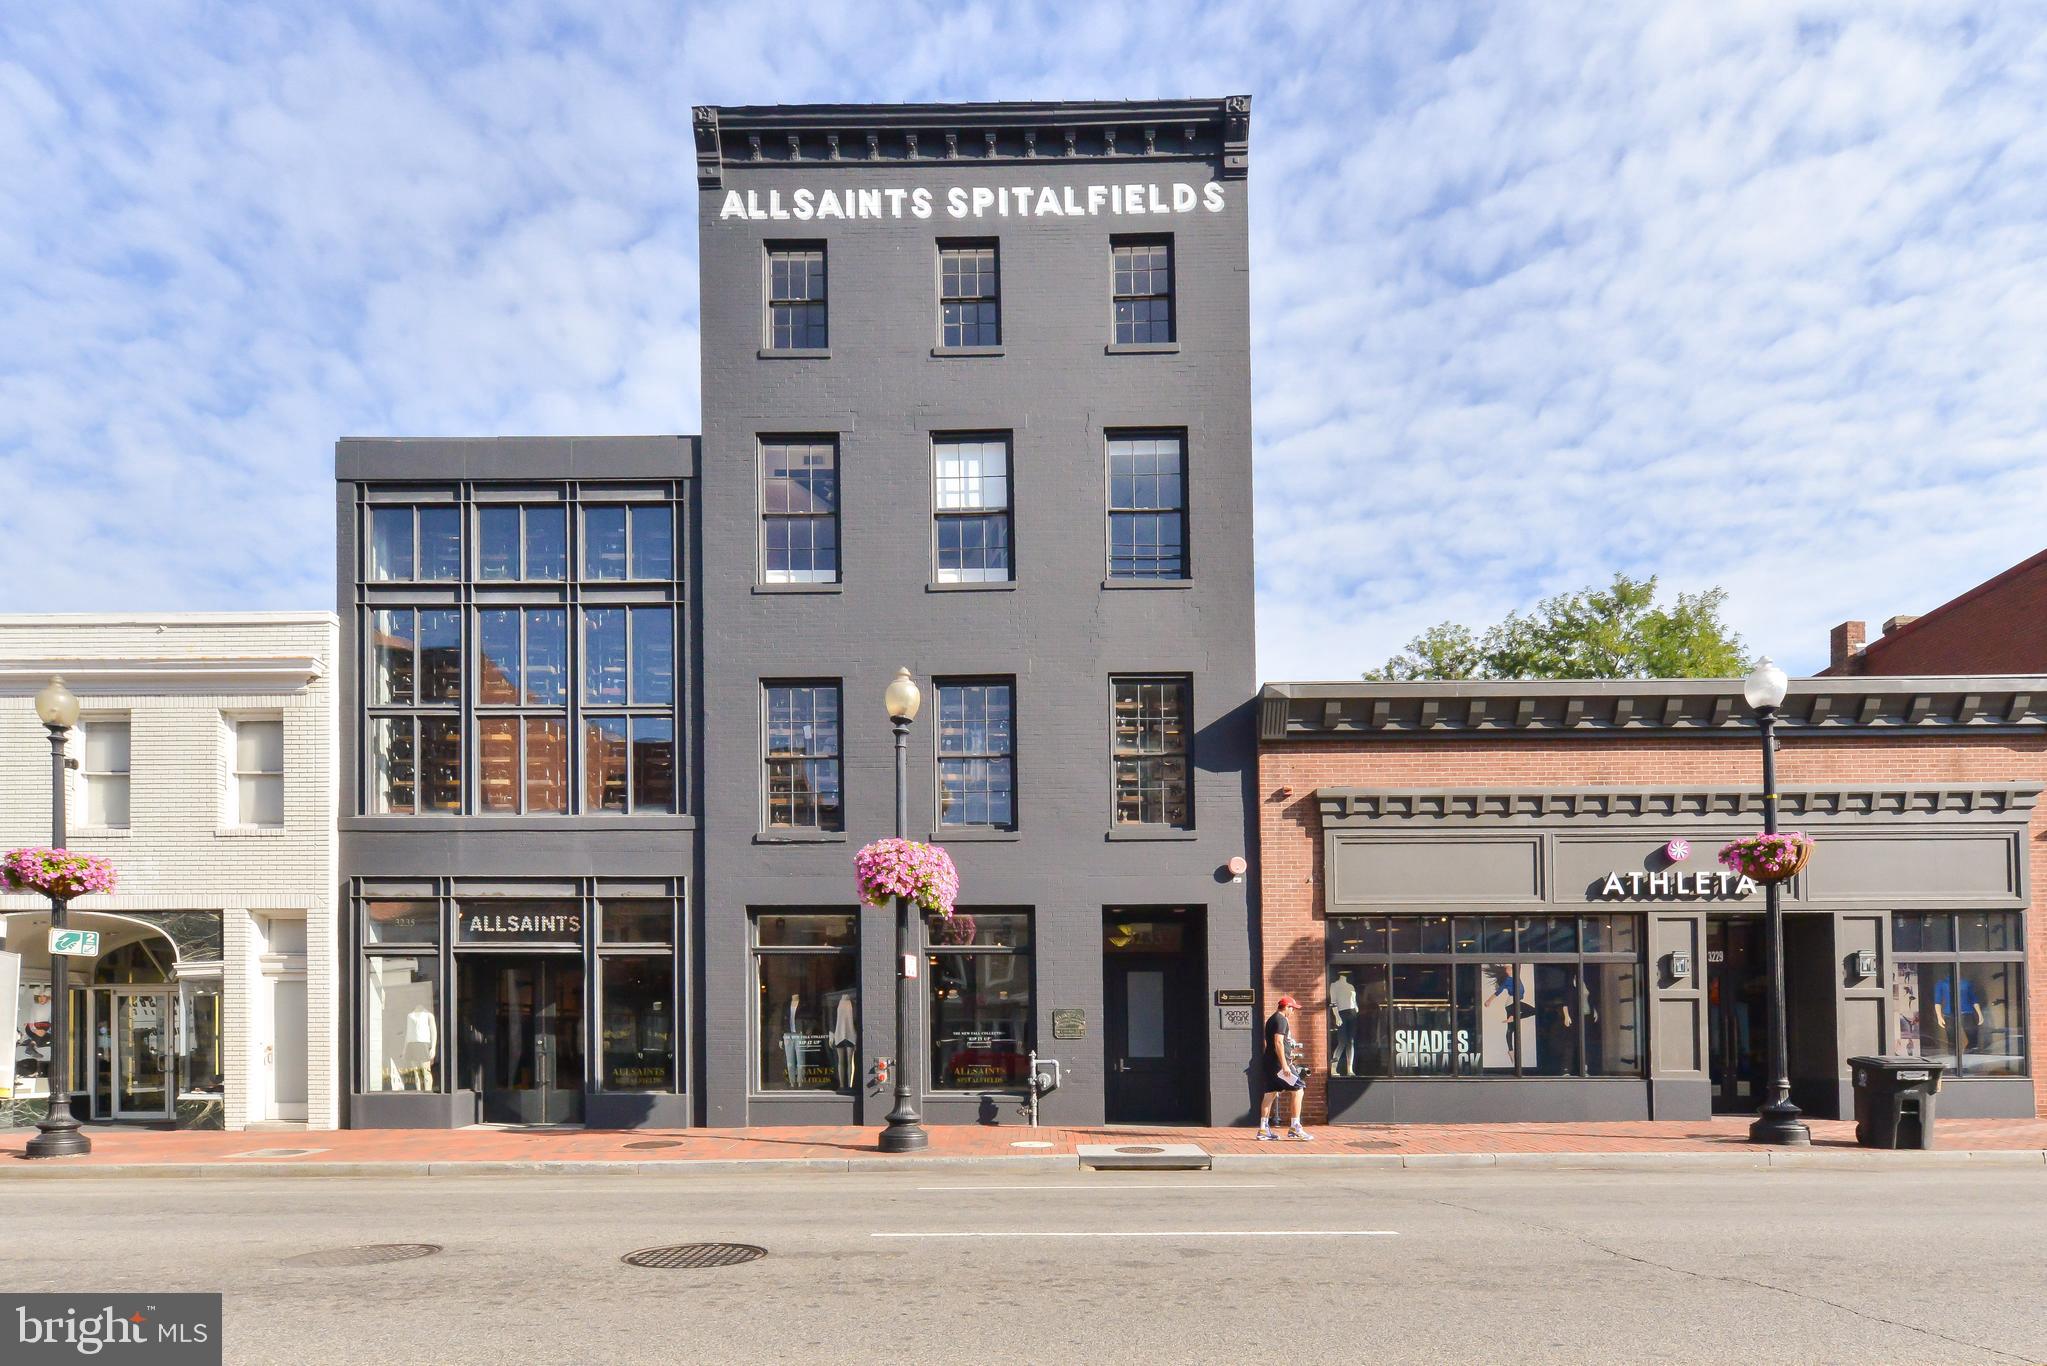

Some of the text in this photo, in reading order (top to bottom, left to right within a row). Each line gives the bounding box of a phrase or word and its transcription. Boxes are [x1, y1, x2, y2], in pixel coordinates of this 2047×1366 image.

[719, 181, 1226, 220] ALLSAINTS SPITALFIELDS
[1602, 871, 1758, 895] ATHLETA
[395, 918, 416, 928] 3235
[470, 915, 582, 932] ALLSAINTS
[86, 933, 95, 941] 2
[1708, 951, 1723, 962] 3229
[1395, 1029, 1469, 1052] SHADES
[954, 1067, 1006, 1075] ALLSAINTS
